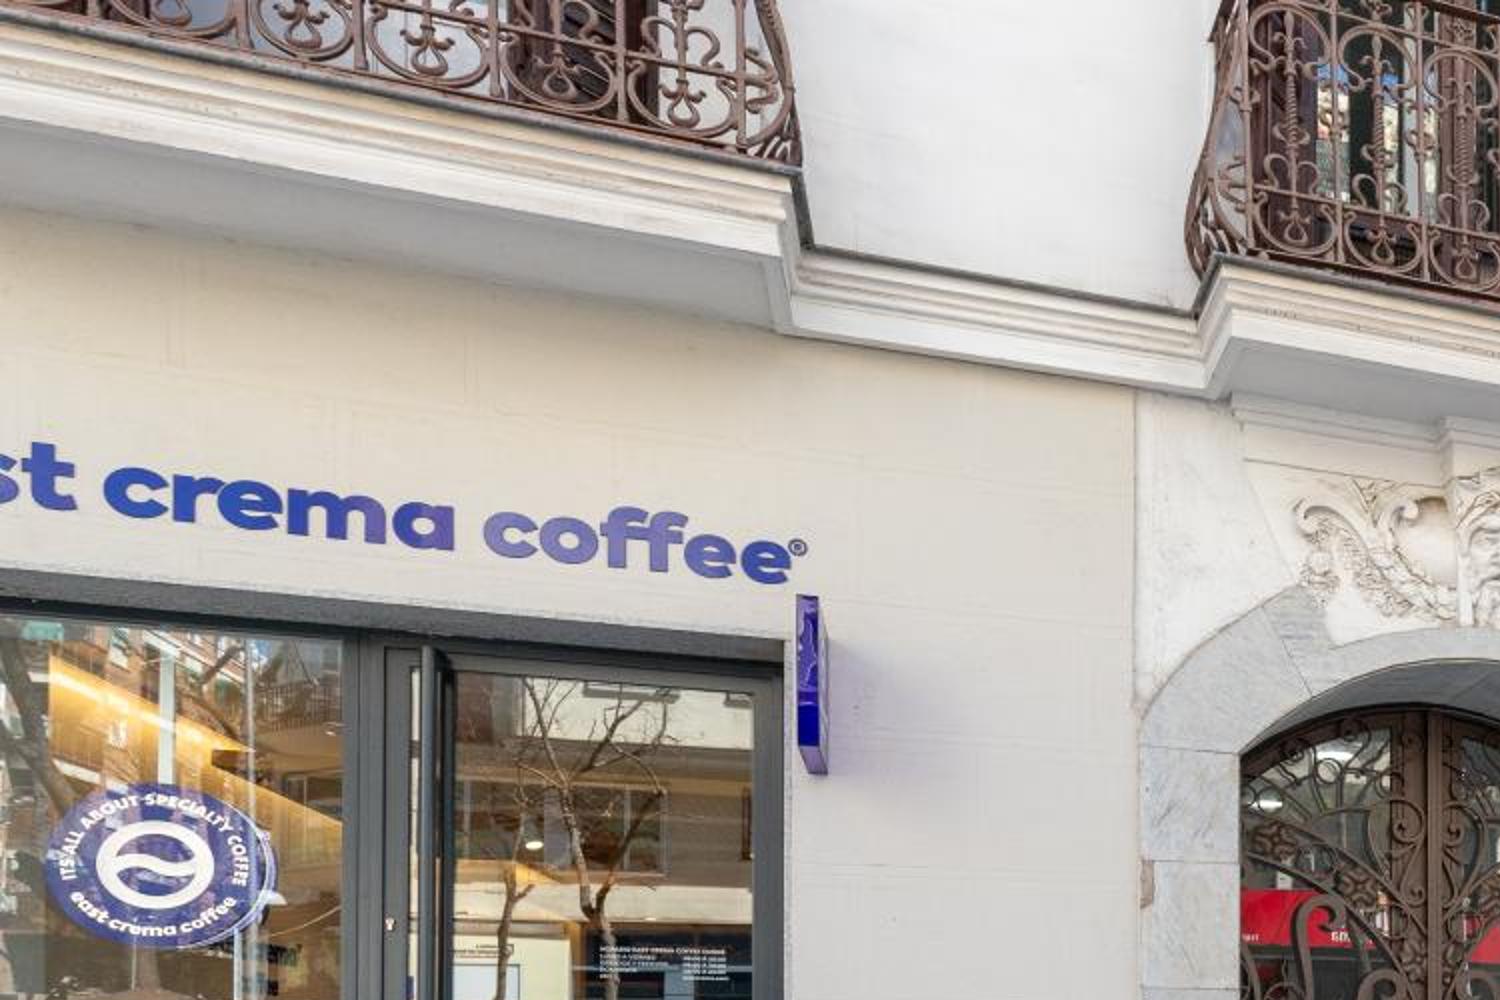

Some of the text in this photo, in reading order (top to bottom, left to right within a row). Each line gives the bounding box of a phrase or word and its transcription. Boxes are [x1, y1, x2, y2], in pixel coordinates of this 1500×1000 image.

[102, 466, 455, 552] crema
[80, 794, 140, 831] ABOUT
[142, 791, 234, 833] SPECIALTY
[227, 834, 251, 888] COFFEE
[70, 891, 238, 938] east crema coffee
